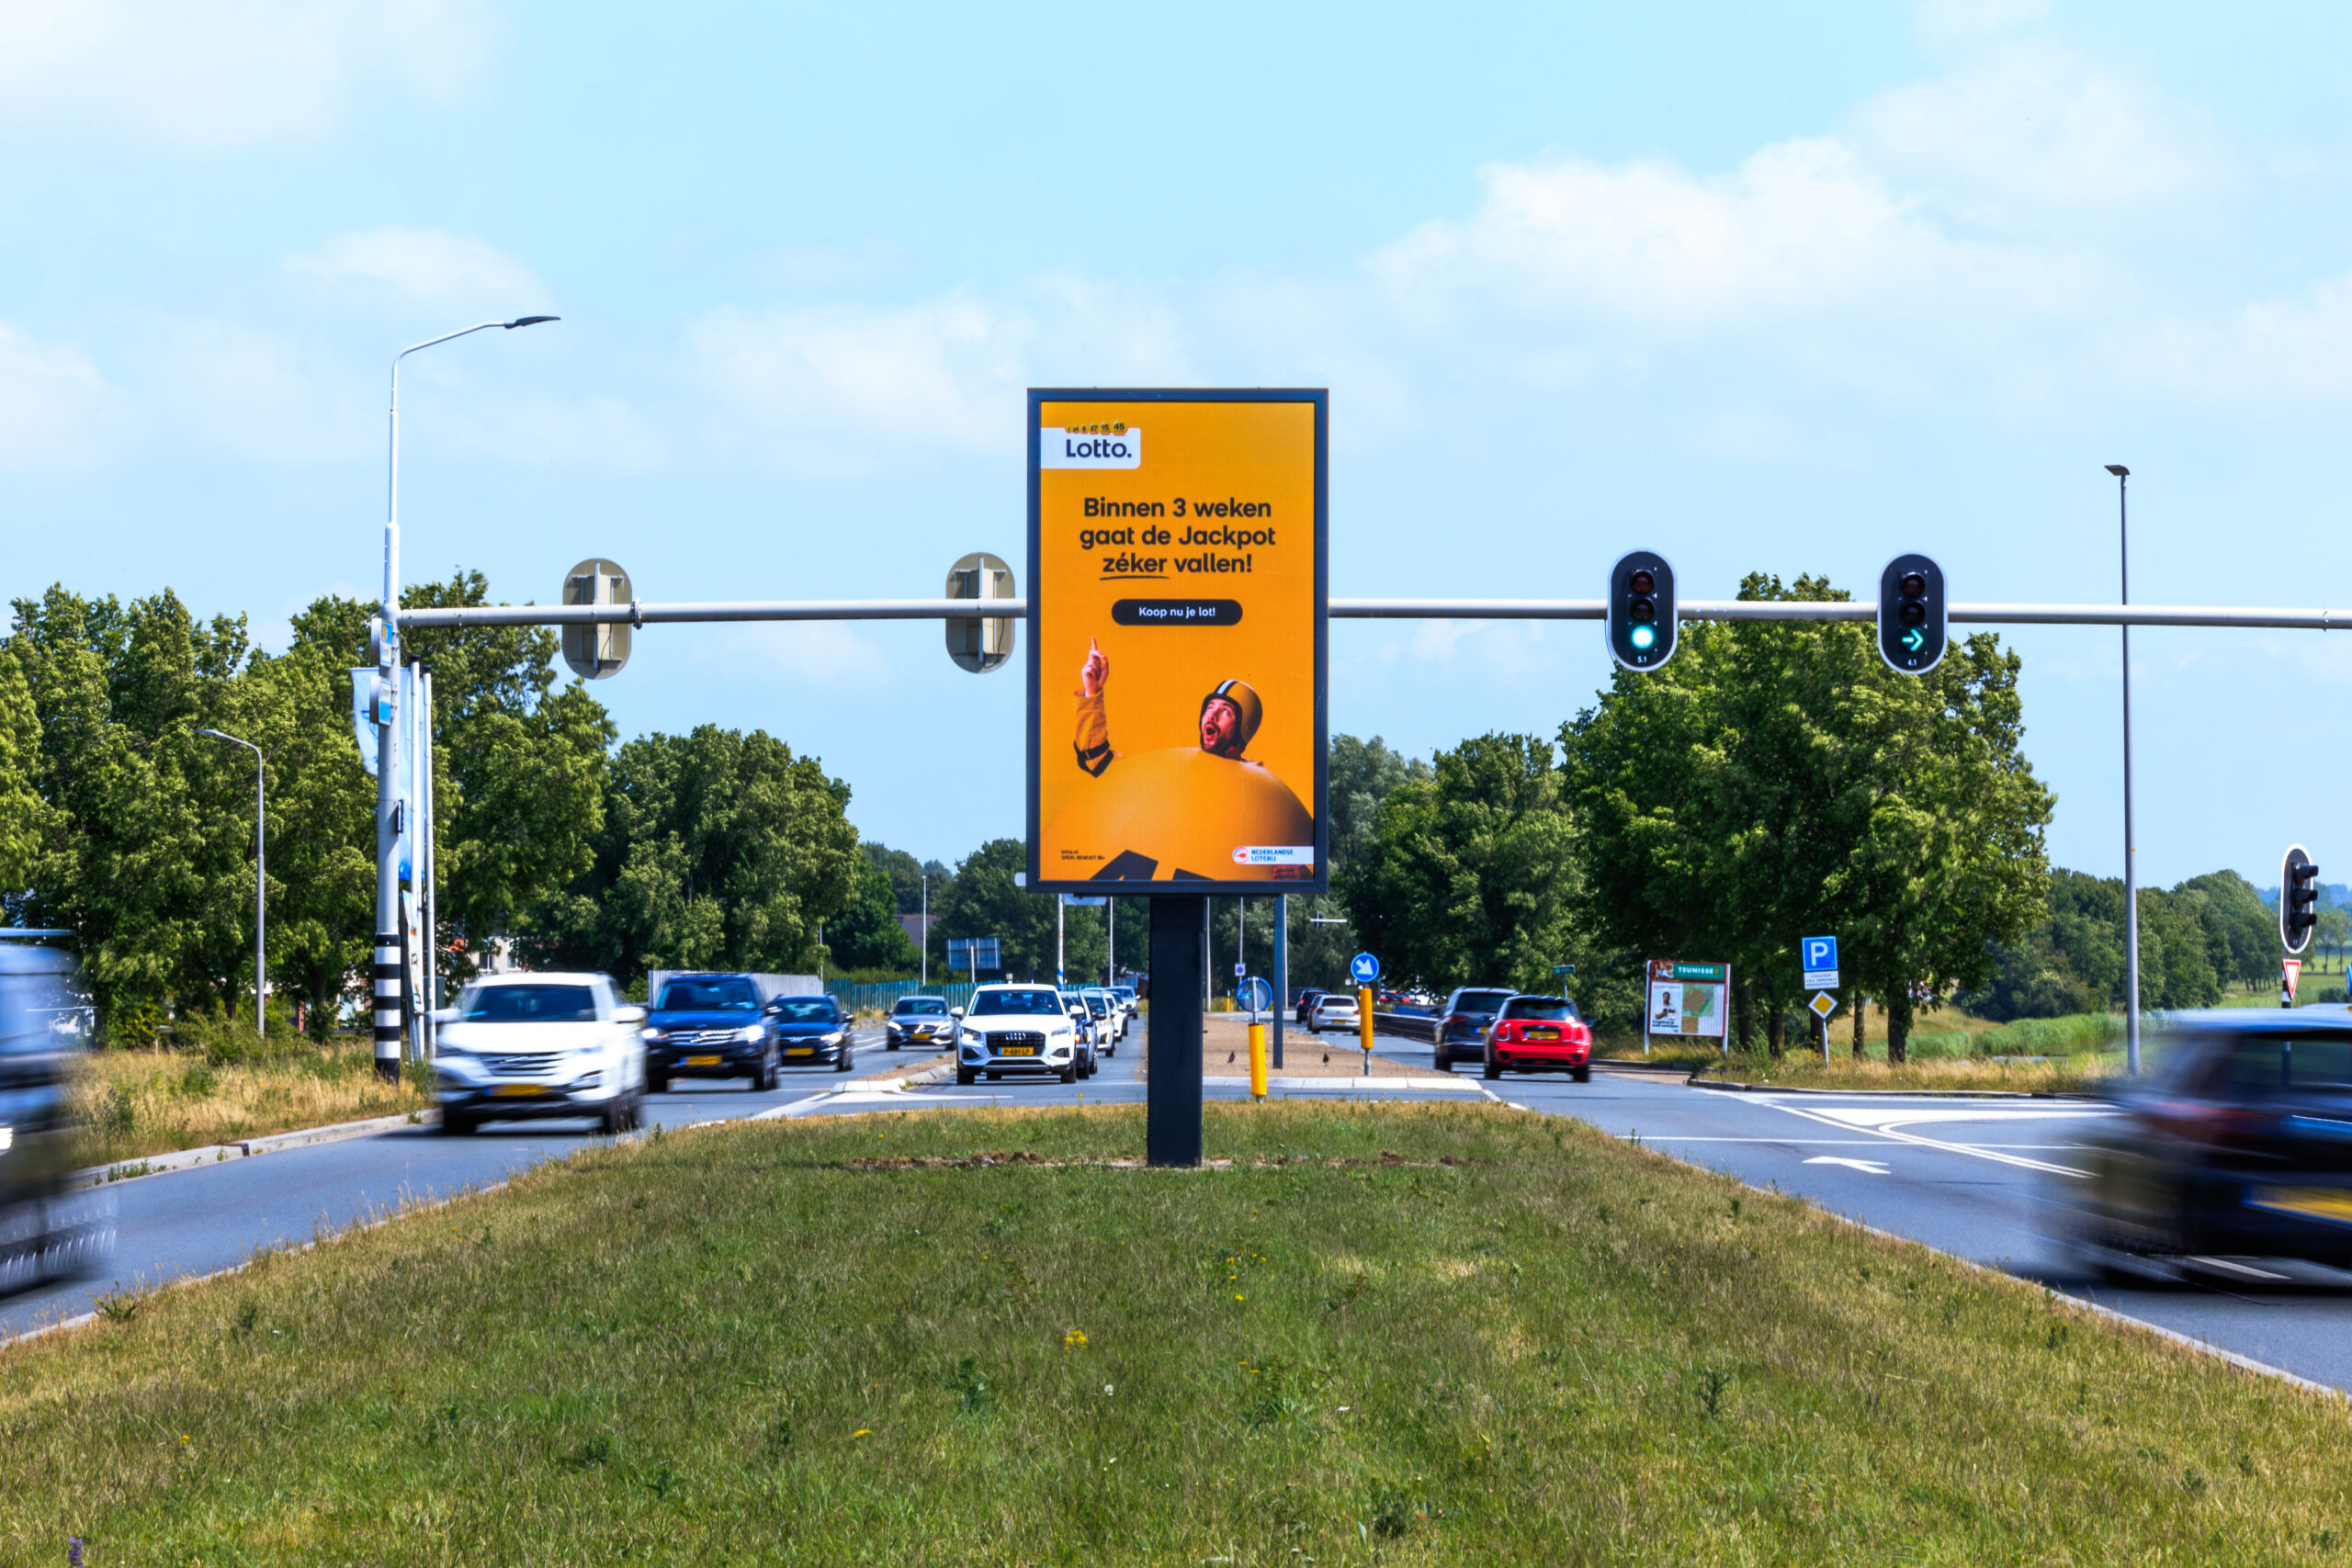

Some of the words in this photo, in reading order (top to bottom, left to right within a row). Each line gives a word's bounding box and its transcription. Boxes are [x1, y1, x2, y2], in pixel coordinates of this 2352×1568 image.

[1114, 423, 1125, 431] 45
[1066, 439, 1132, 458] Lotto.
[1084, 496, 1165, 517] Binnen
[1172, 497, 1187, 517] 3
[1193, 497, 1272, 517] weken
[1080, 526, 1135, 550] gaat
[1141, 525, 1171, 545] de
[1178, 525, 1275, 550] Jackpot
[1102, 552, 1168, 572] zéker
[1173, 553, 1252, 572] vallen!
[1138, 606, 1167, 619] Koop
[1170, 607, 1183, 616] nu
[1185, 606, 1196, 619] je
[1198, 606, 1216, 616] lot!
[1810, 942, 1828, 966] P
